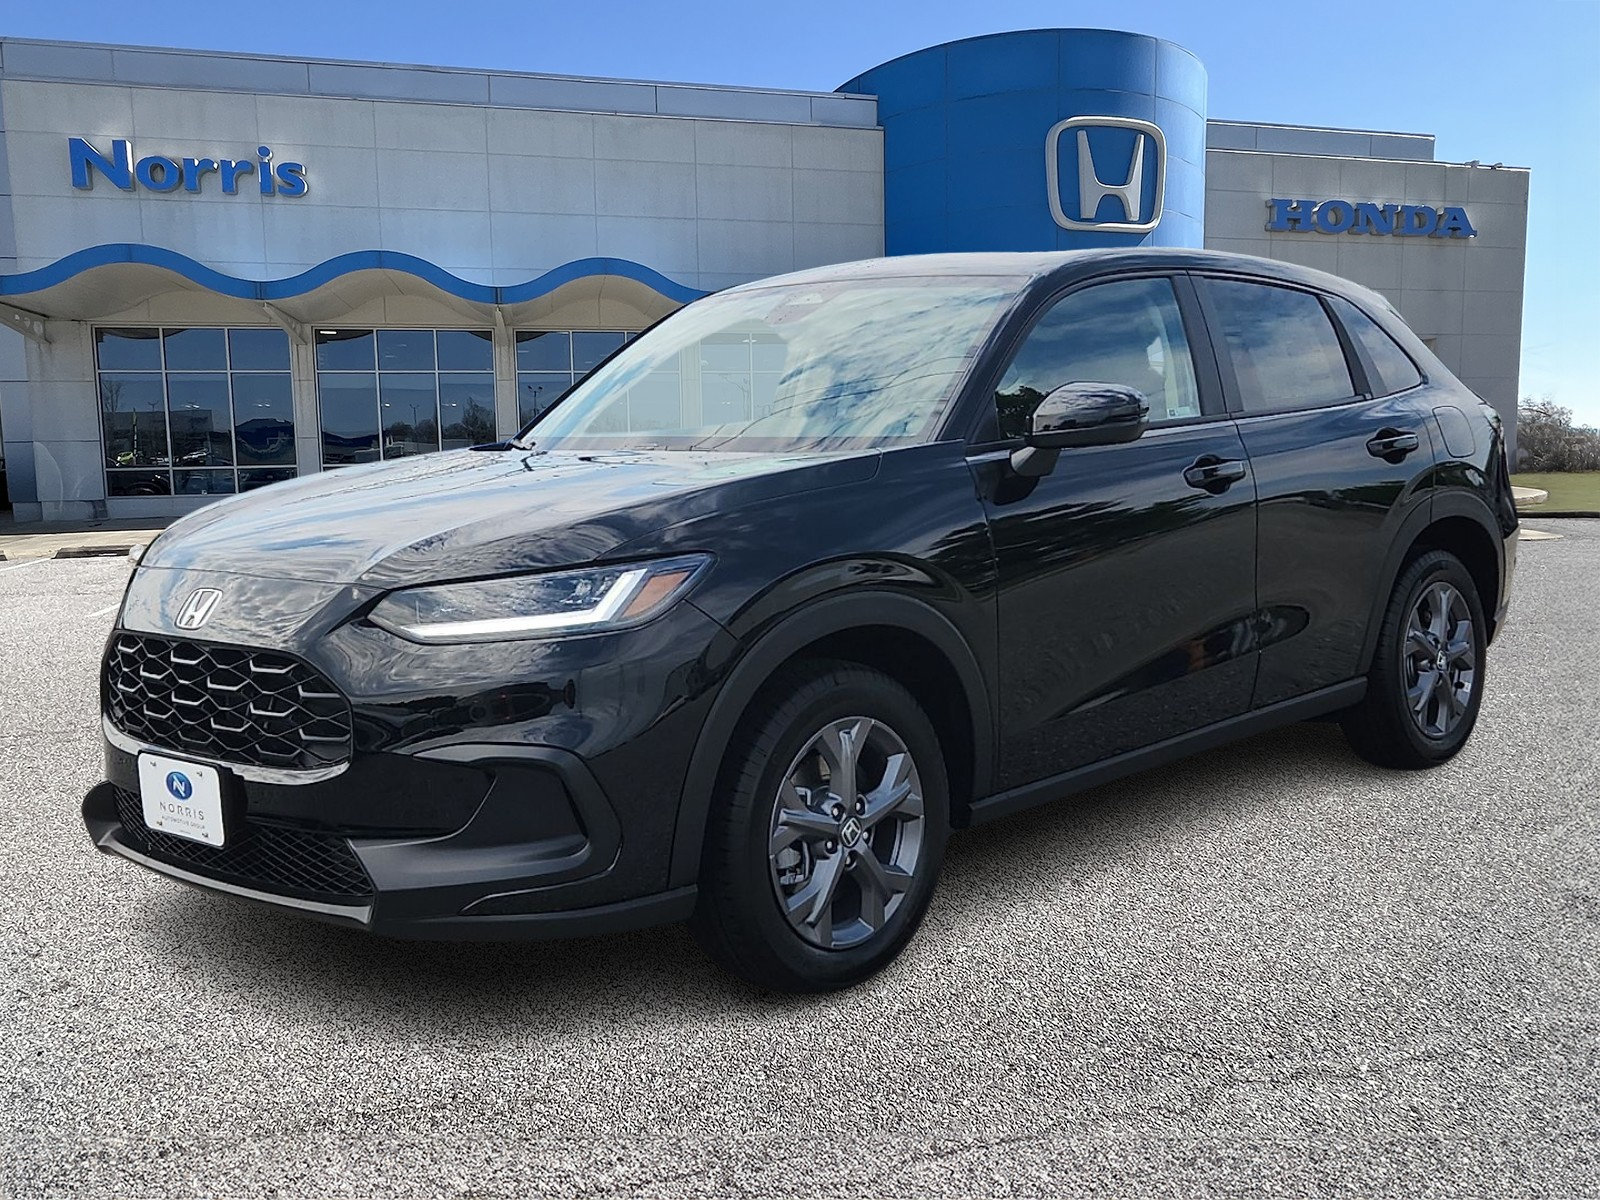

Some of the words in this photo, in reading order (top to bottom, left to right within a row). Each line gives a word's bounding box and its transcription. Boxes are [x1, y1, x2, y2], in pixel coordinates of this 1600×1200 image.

[68, 137, 309, 197] Norris
[1265, 198, 1478, 239] HONDA
[159, 801, 205, 821] NORRIS
